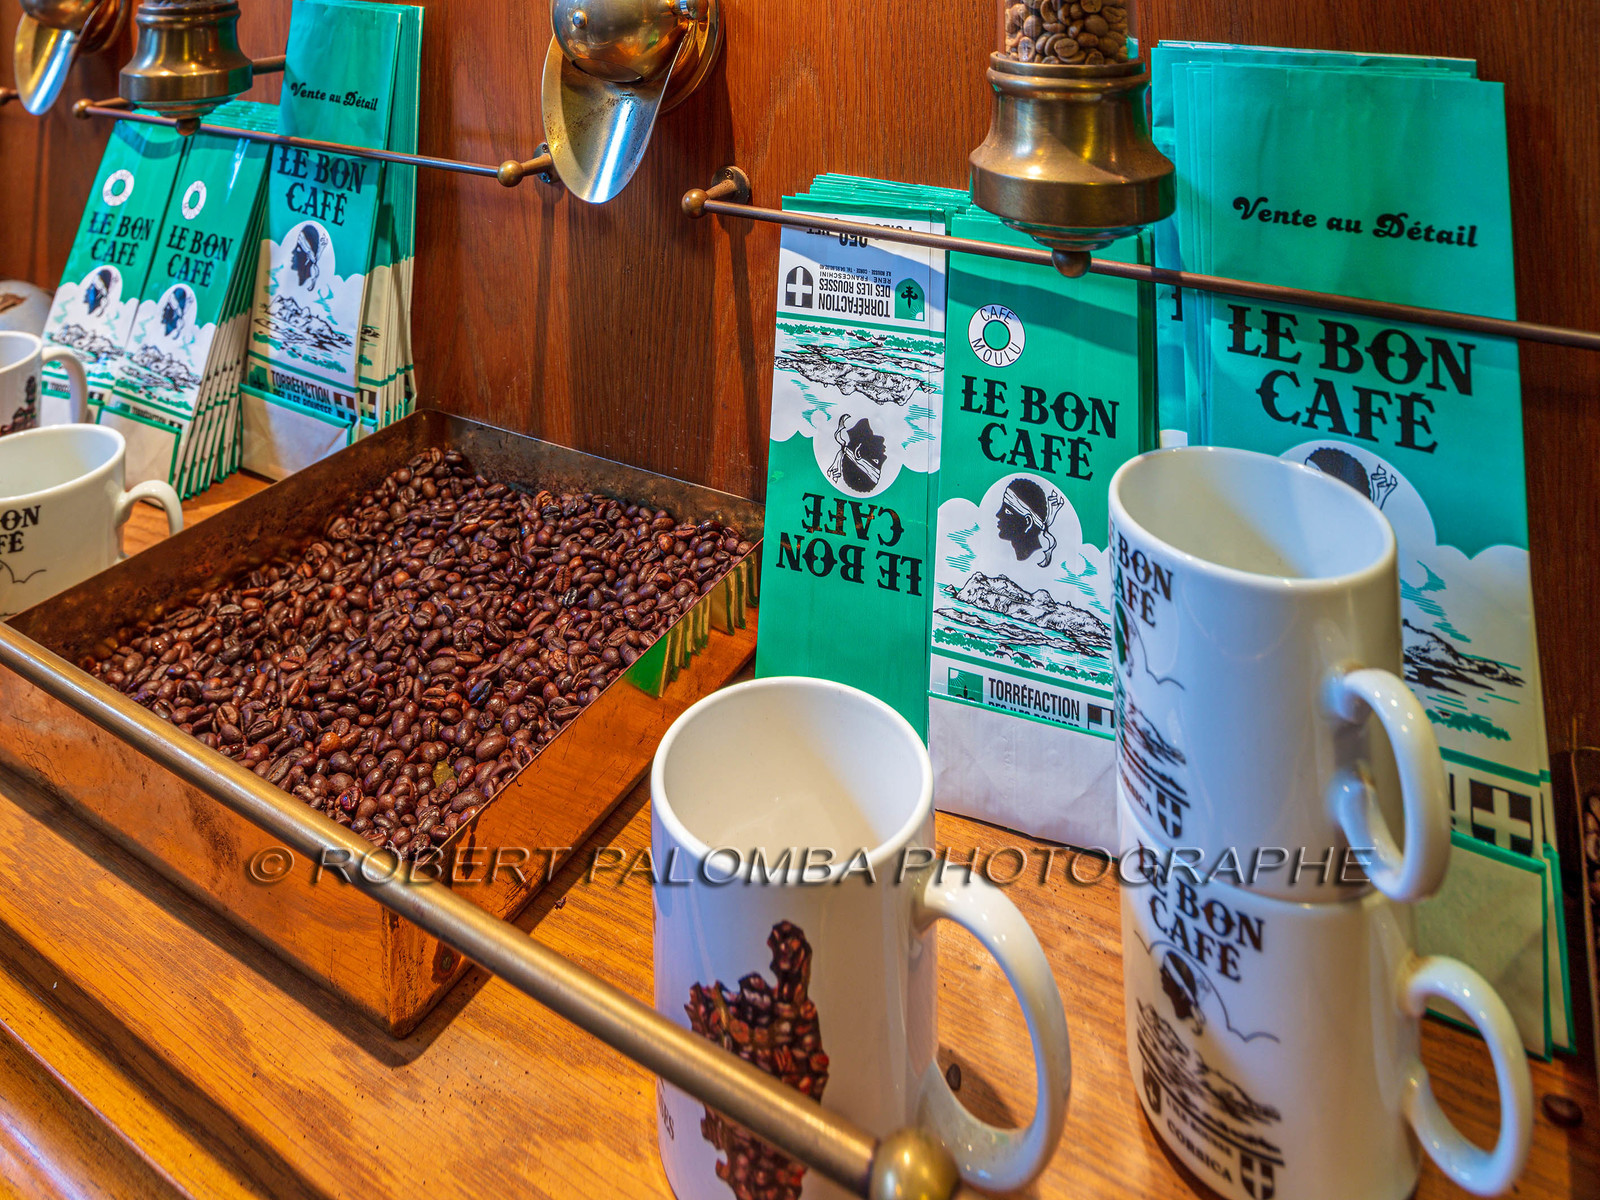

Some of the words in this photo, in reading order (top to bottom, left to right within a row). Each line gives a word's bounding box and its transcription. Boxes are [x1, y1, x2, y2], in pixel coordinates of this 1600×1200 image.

[290, 82, 326, 101] Vente
[328, 93, 341, 104] au
[343, 91, 379, 111] Détail
[277, 145, 310, 179] LE
[314, 153, 367, 195] BON
[87, 211, 115, 236] LE
[115, 216, 155, 241] BON
[285, 182, 348, 227] CAFÉ
[1232, 196, 1317, 228] Vente
[1326, 215, 1364, 234] au
[1372, 212, 1479, 248] Détail
[166, 225, 190, 251] LE
[188, 230, 234, 262] BON
[167, 253, 215, 288] CAFÉ
[819, 271, 869, 282] FRANCESCHINI
[819, 277, 854, 294] ROUSSES
[856, 281, 873, 296] ILES
[875, 284, 891, 298] DES
[818, 292, 891, 318] TORRÉFACTION
[979, 305, 1015, 325] CAFE
[971, 337, 1022, 366] MOULU
[1227, 303, 1302, 365] LE
[1317, 318, 1476, 397] BON
[960, 374, 1010, 418] LE
[1020, 384, 1120, 439] BON
[1255, 369, 1439, 455] CAFÉ
[977, 422, 1094, 482] CAFÉ
[0, 505, 41, 531] ON
[801, 492, 905, 547] CAFÉ
[776, 532, 866, 584] BON
[876, 550, 923, 597] LE
[1117, 531, 1174, 603] BON
[987, 677, 1081, 722] TORRÉFACTION
[1175, 876, 1266, 954] BON
